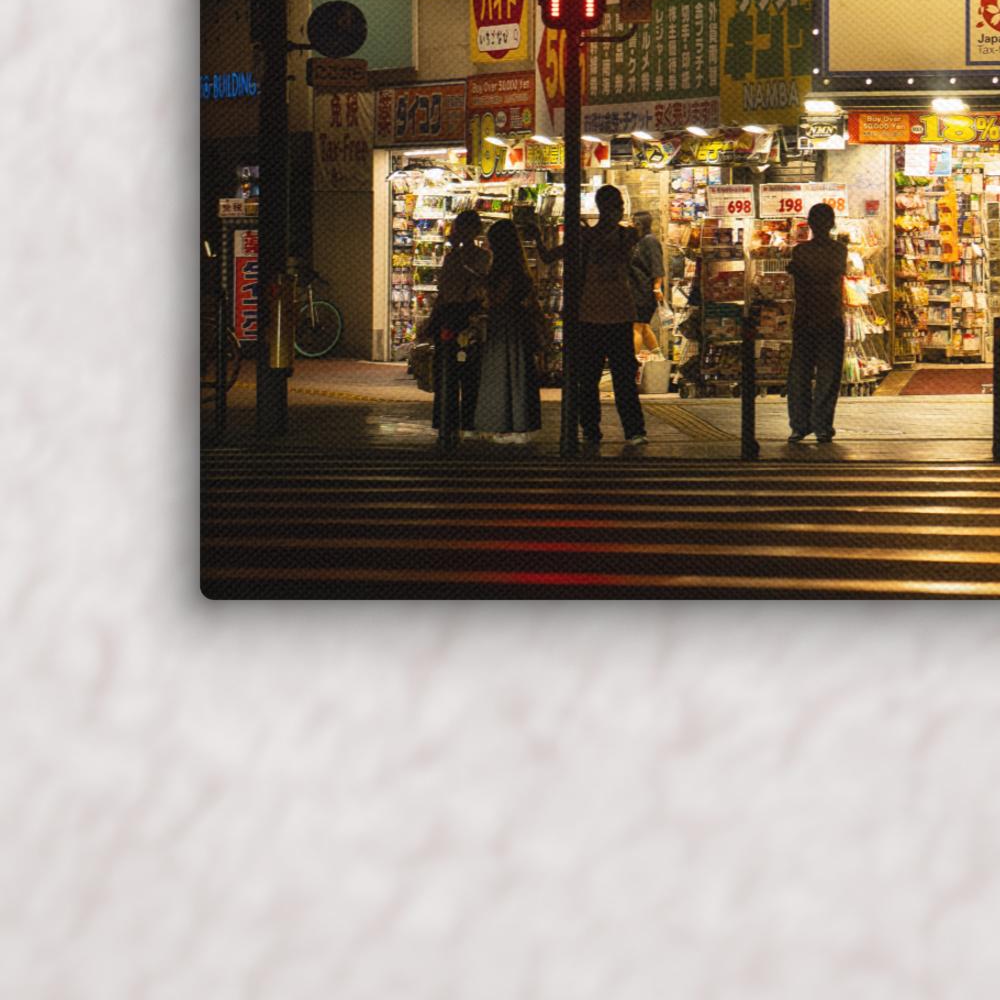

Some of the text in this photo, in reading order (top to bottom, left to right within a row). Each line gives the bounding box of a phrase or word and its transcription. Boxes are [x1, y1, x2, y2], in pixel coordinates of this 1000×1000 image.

[742, 82, 799, 113] NAMBA
[727, 200, 752, 214] 698
[778, 198, 803, 213] 198
